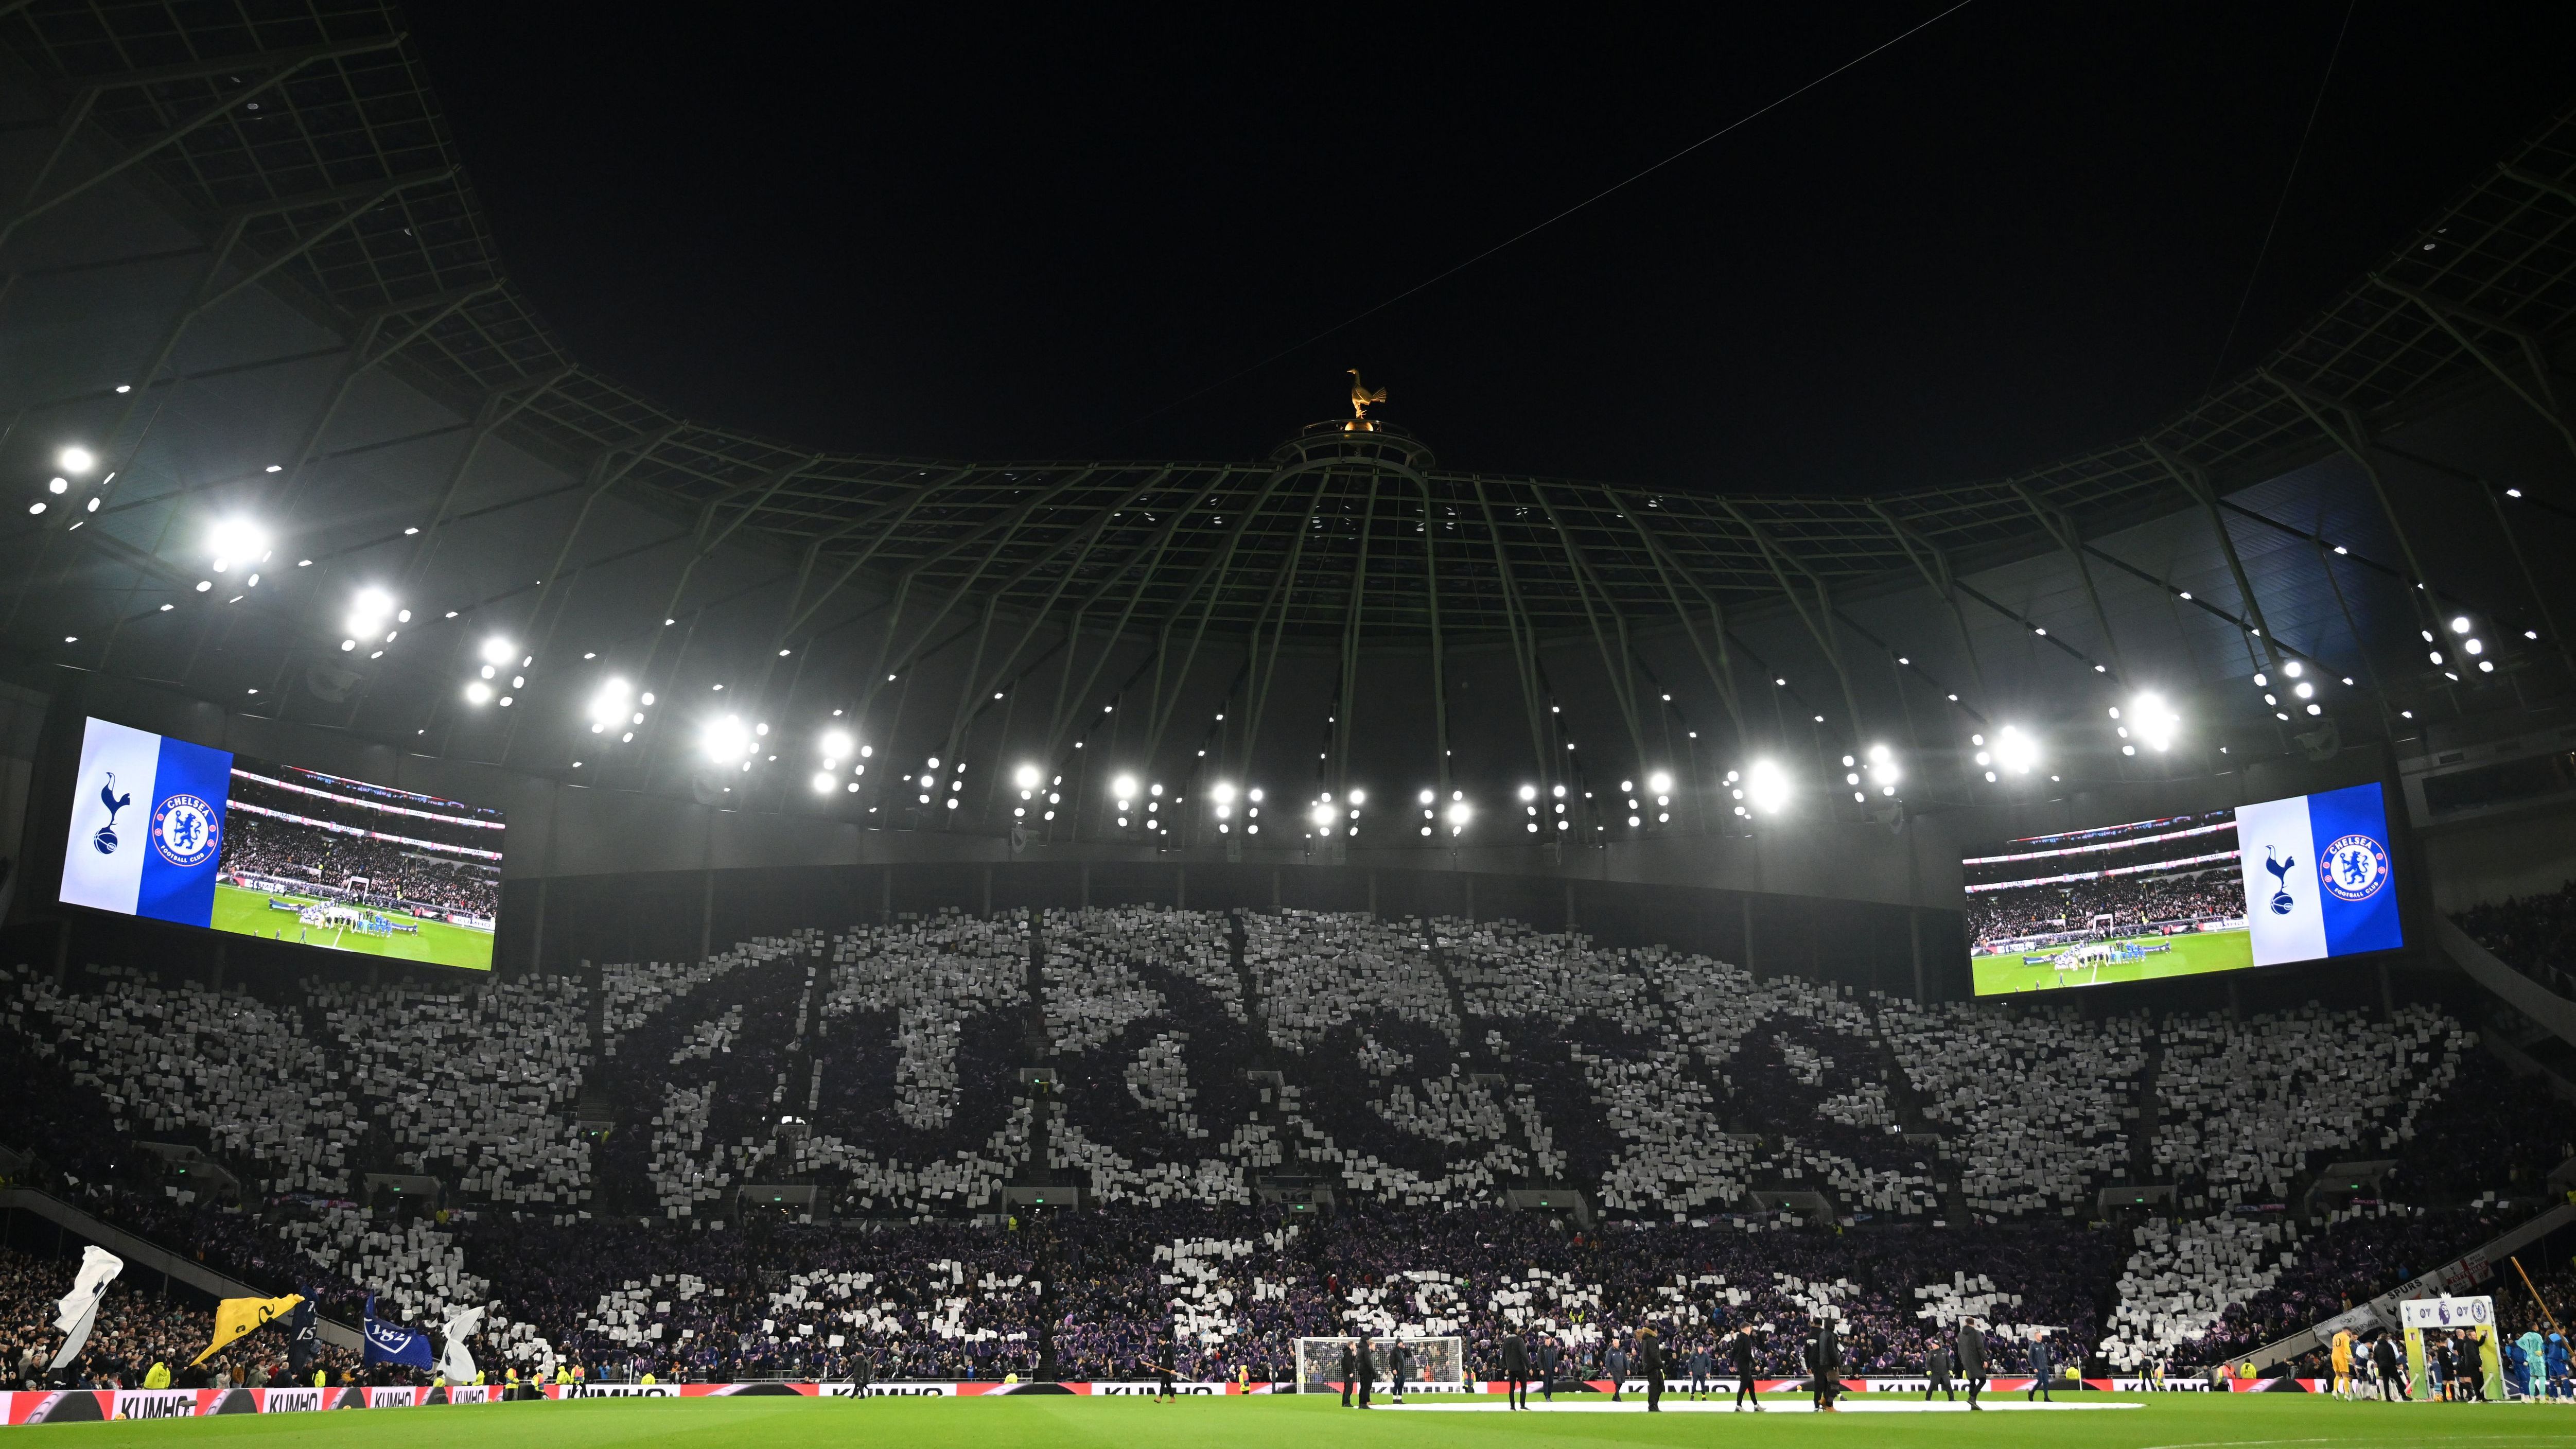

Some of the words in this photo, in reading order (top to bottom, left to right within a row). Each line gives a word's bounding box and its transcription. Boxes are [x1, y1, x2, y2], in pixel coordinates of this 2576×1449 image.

[167, 797, 209, 817] CHELSEA
[161, 845, 187, 863] FOOTBALL
[190, 852, 204, 862] CLUB
[2329, 837, 2372, 854] CHELSEA
[2334, 888, 2363, 898] FOOTBALL
[2365, 881, 2379, 894] CLUB
[2388, 1279, 2422, 1299] SPURS
[270, 1393, 318, 1413] KUMHO
[375, 1391, 411, 1408] KUMHO
[455, 1390, 484, 1405] KUMHO
